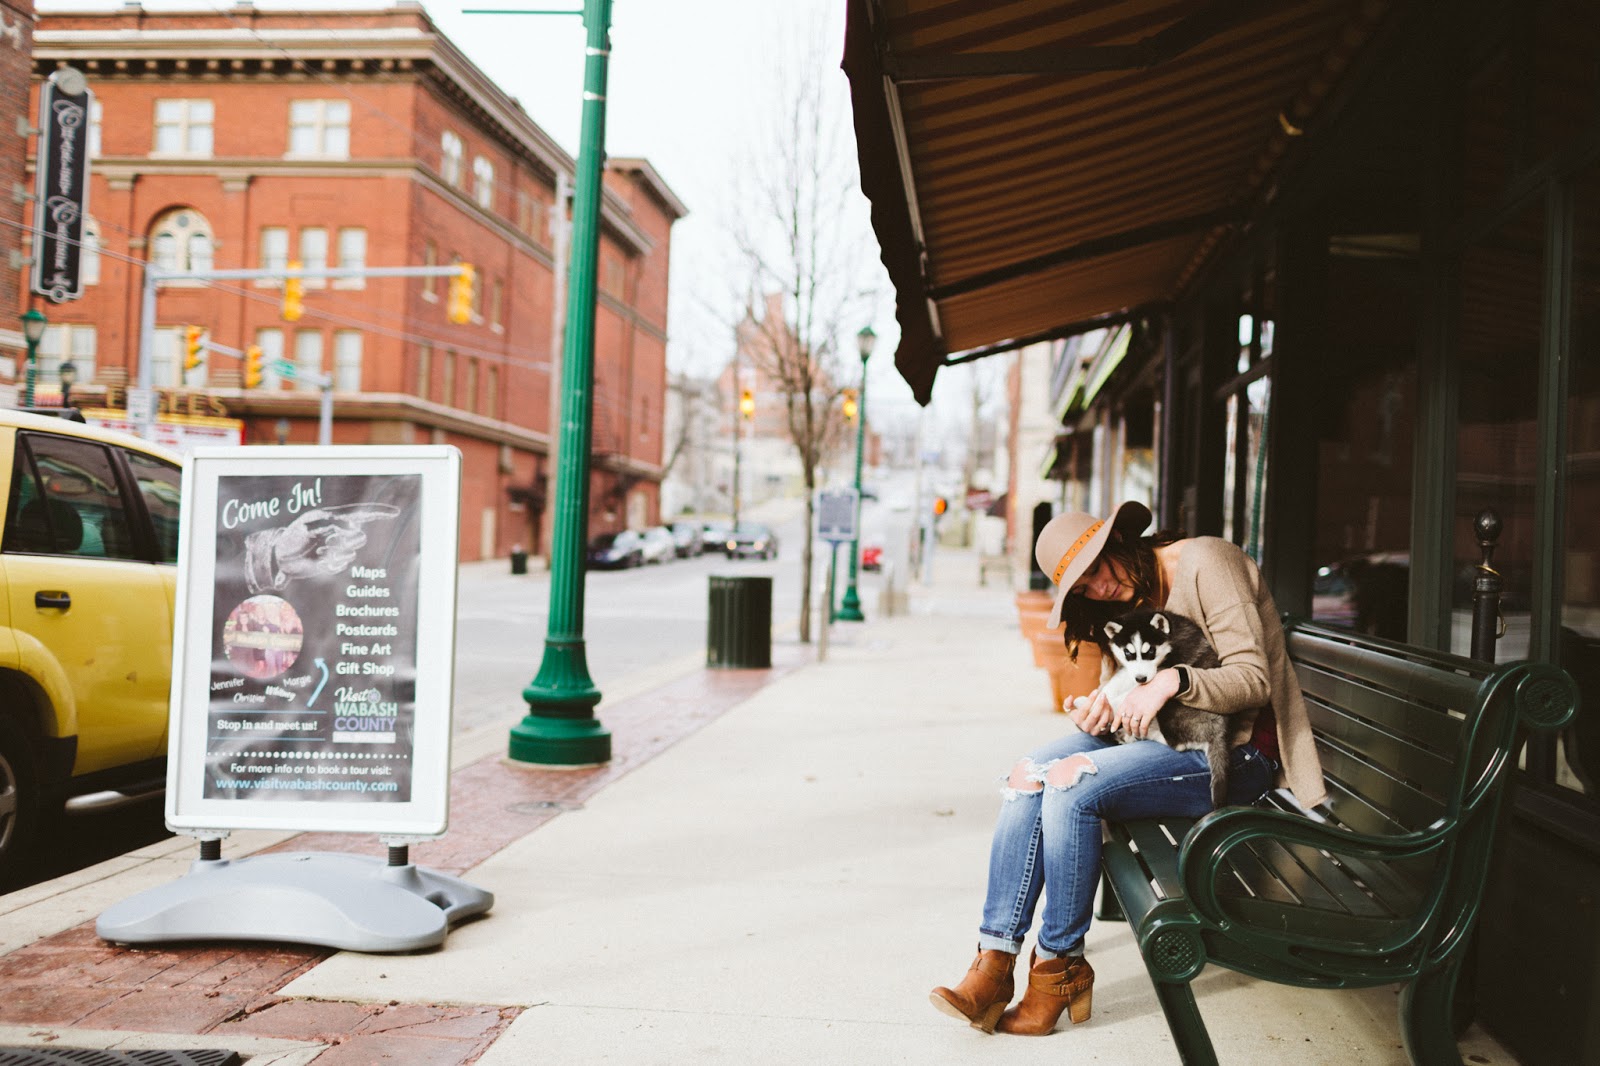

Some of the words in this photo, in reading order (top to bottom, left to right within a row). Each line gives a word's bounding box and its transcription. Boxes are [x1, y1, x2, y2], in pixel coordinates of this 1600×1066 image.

[106, 386, 228, 417] ELES
[222, 497, 280, 529] Come
[287, 478, 322, 513] In!
[351, 566, 387, 580] Maps
[346, 585, 390, 597] Guides
[336, 604, 399, 617] Brochures
[336, 623, 398, 636] Postcards
[341, 643, 368, 655] Fine
[371, 643, 391, 655] Art
[336, 662, 360, 675] Gift
[362, 662, 395, 677] Shop
[211, 678, 245, 691] Jennifer
[283, 675, 312, 687] Margie
[233, 692, 266, 703] Christine
[334, 687, 370, 703] Visit
[334, 702, 398, 717] WABASH
[217, 719, 241, 731] Stop
[242, 719, 253, 730] in
[254, 720, 274, 730] and
[275, 721, 301, 731] meet
[301, 720, 318, 731] us!
[334, 717, 396, 731] COUNTY
[230, 763, 246, 773] For
[248, 765, 273, 774] more
[274, 764, 293, 774] info
[294, 766, 304, 774] or
[306, 765, 316, 774] to
[318, 764, 340, 774] book
[341, 766, 348, 775] a
[350, 766, 368, 775] tour
[370, 765, 393, 775] visit:
[215, 777, 398, 794] www.visitwabashcounty.com
